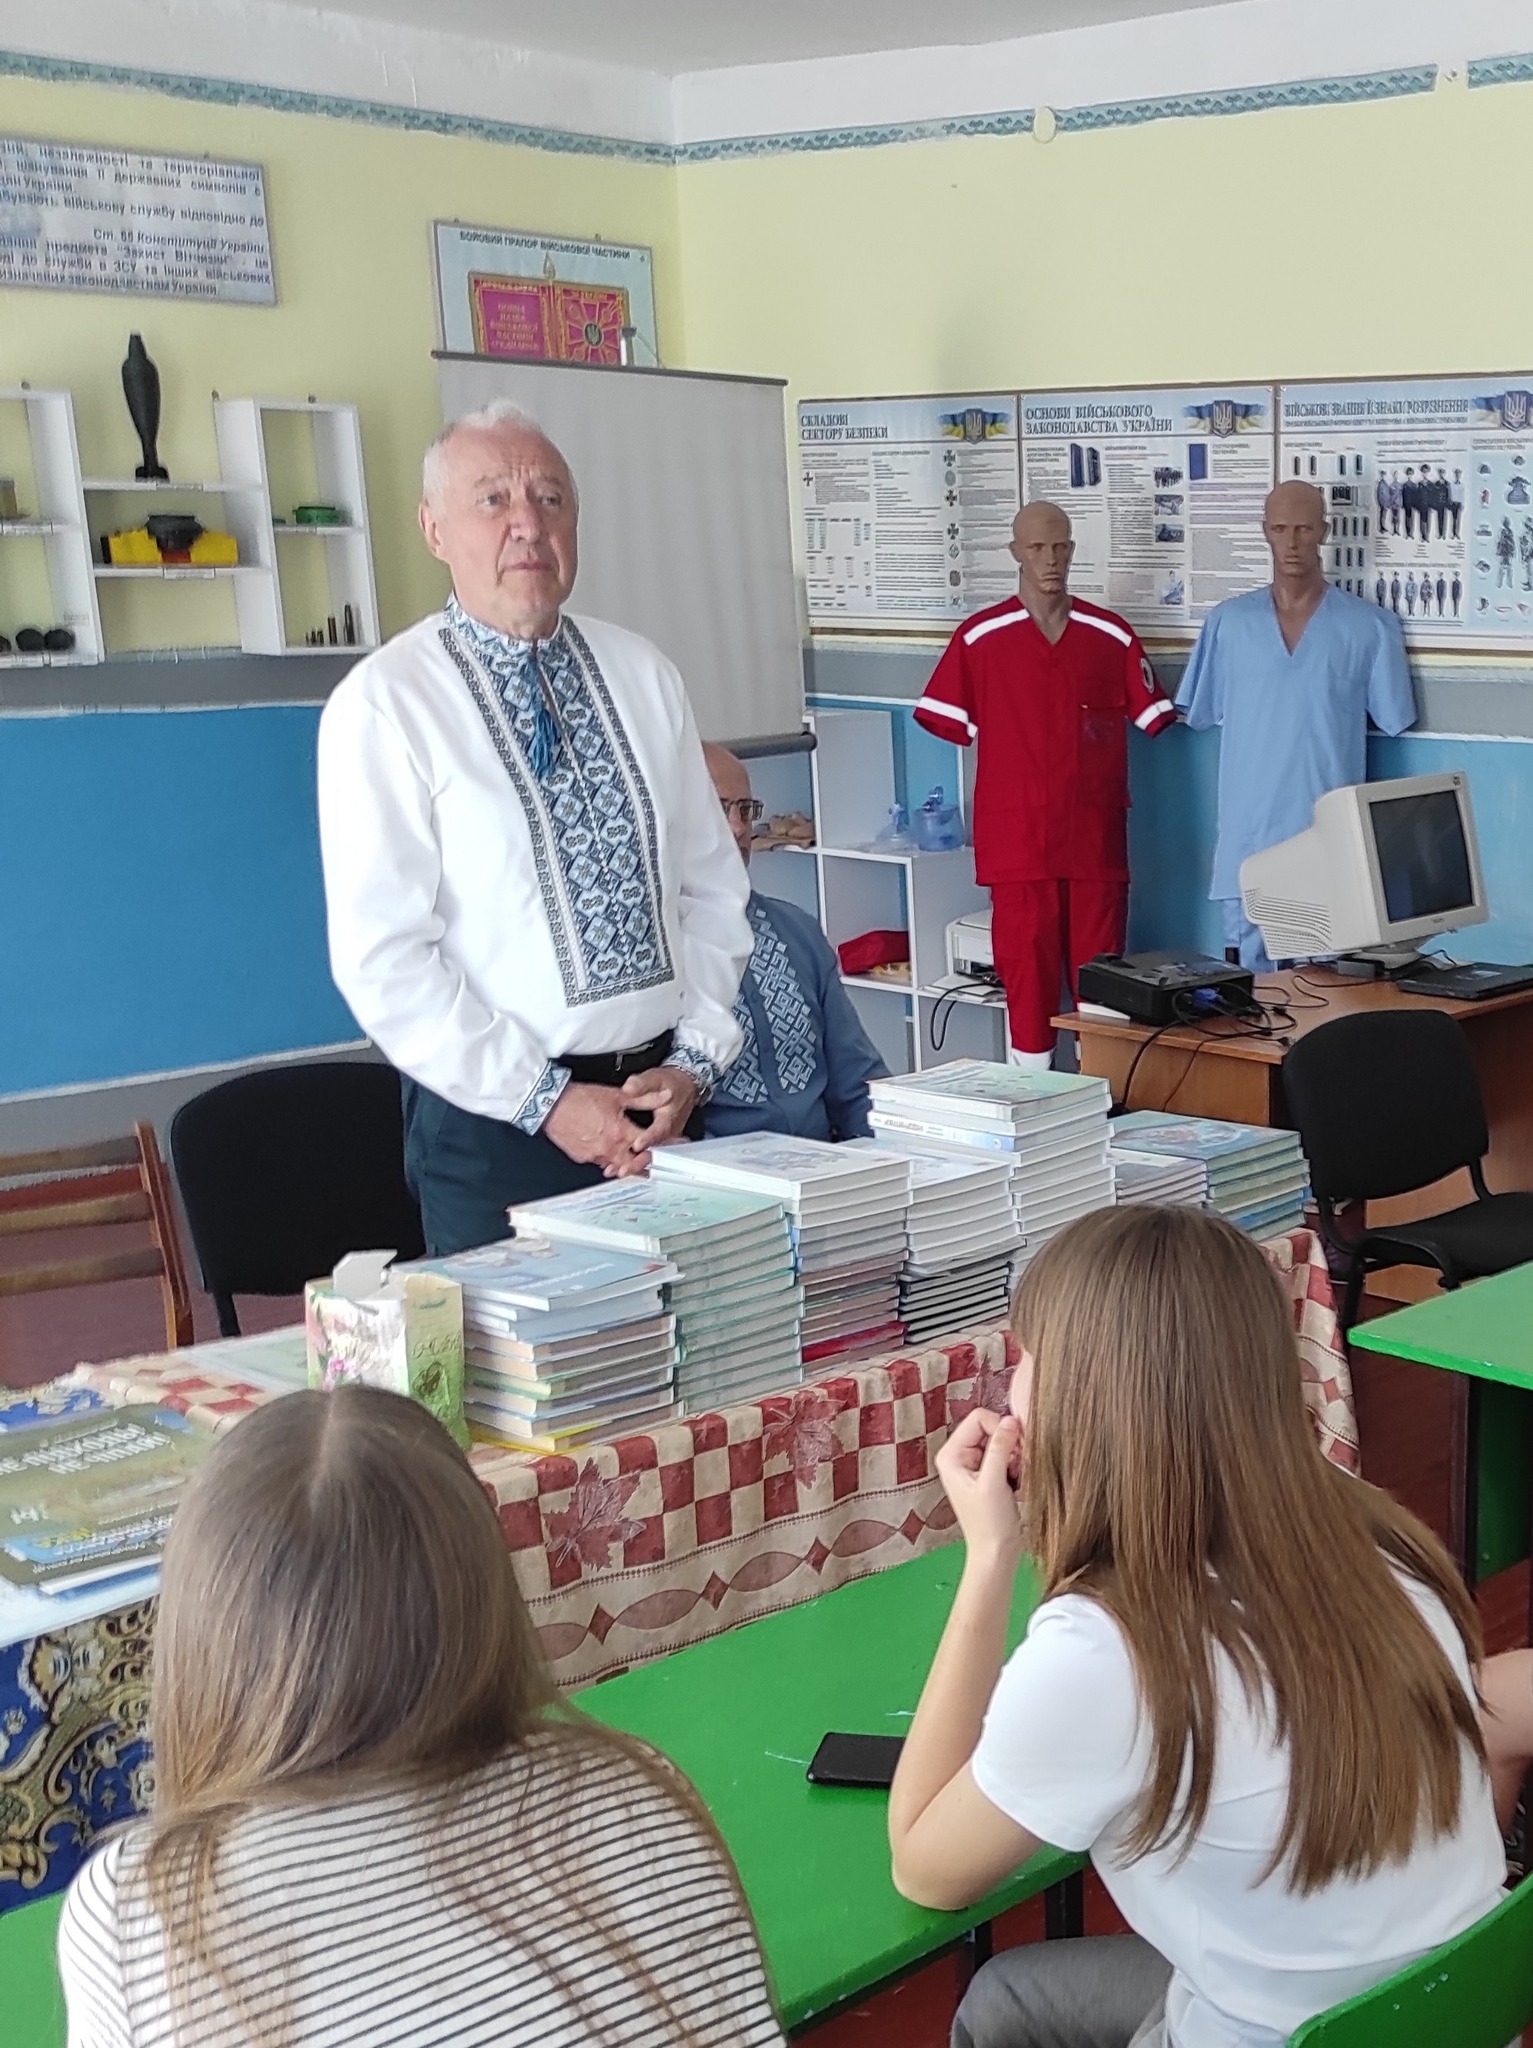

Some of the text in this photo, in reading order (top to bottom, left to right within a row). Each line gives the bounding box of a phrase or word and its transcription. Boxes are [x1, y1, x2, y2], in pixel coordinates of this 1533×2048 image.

[40, 146, 129, 167] незалежності
[140, 160, 152, 170] та
[165, 162, 260, 181] територіальної
[115, 170, 182, 188] державних
[191, 180, 247, 195] символів
[64, 196, 125, 216] військову
[130, 203, 175, 221] службу
[181, 206, 246, 226] відповідно
[249, 216, 264, 227] до
[46, 241, 108, 257] предмета
[137, 231, 218, 251] Конституції
[459, 230, 631, 260] БОЙОВИЙ ПРАПОР ВІЙСЬКОВОЇ ЧАСТИНИ
[22, 253, 38, 266] до
[45, 255, 92, 271] служби
[99, 261, 107, 272] в
[113, 260, 136, 274] ЗСУ
[145, 265, 158, 275] та
[164, 265, 199, 279] інших
[205, 268, 271, 285] військових
[68, 274, 170, 293] законодавством
[801, 413, 849, 428] СКЛАДОВІ
[1025, 403, 1153, 420] ОСНОВИ ВІЙСЬКОВОГО
[801, 426, 888, 441] СЕКТОРУ БЕЗПЕКИ
[1024, 417, 1172, 435] ЗАКОНОДАВСТВА УКРАЇНИ
